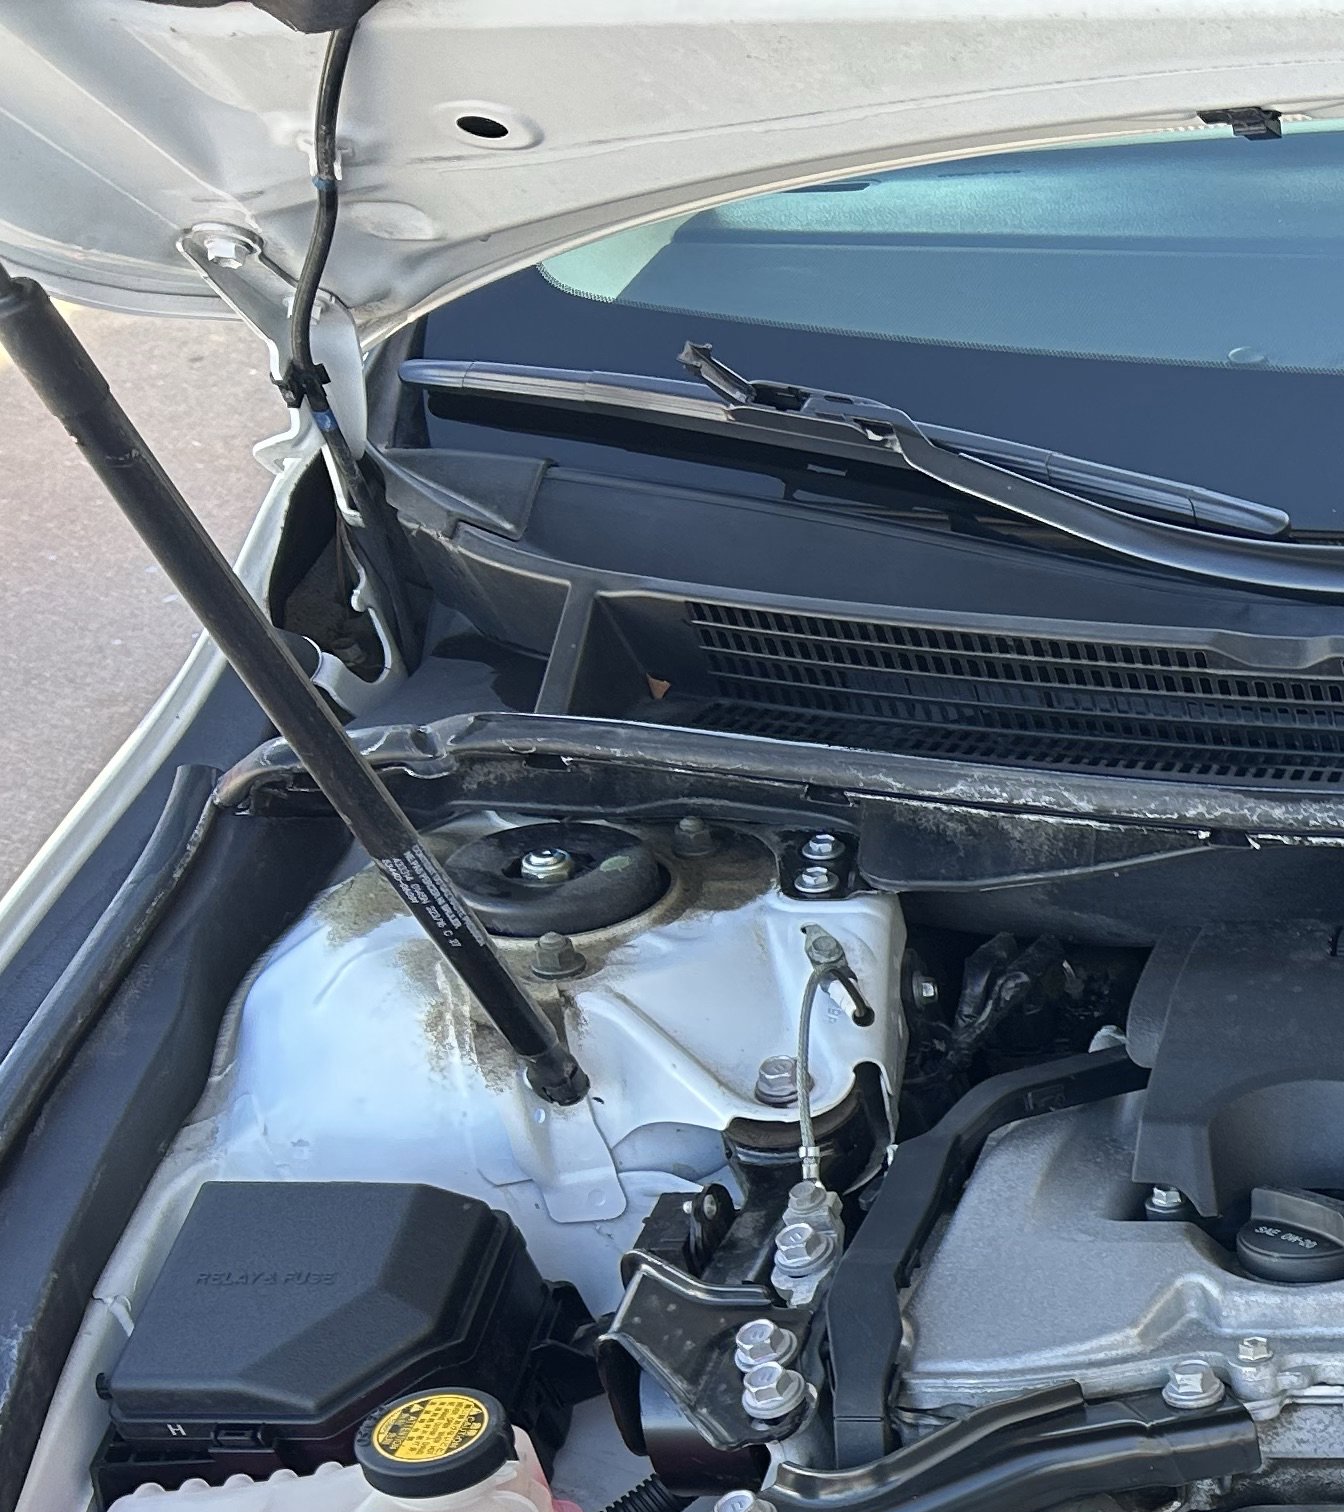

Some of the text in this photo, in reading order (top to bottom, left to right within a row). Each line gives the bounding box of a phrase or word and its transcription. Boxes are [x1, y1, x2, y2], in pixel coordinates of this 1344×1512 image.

[1254, 1226, 1318, 1249] SAE 0W-20
[167, 1423, 187, 1436] H
